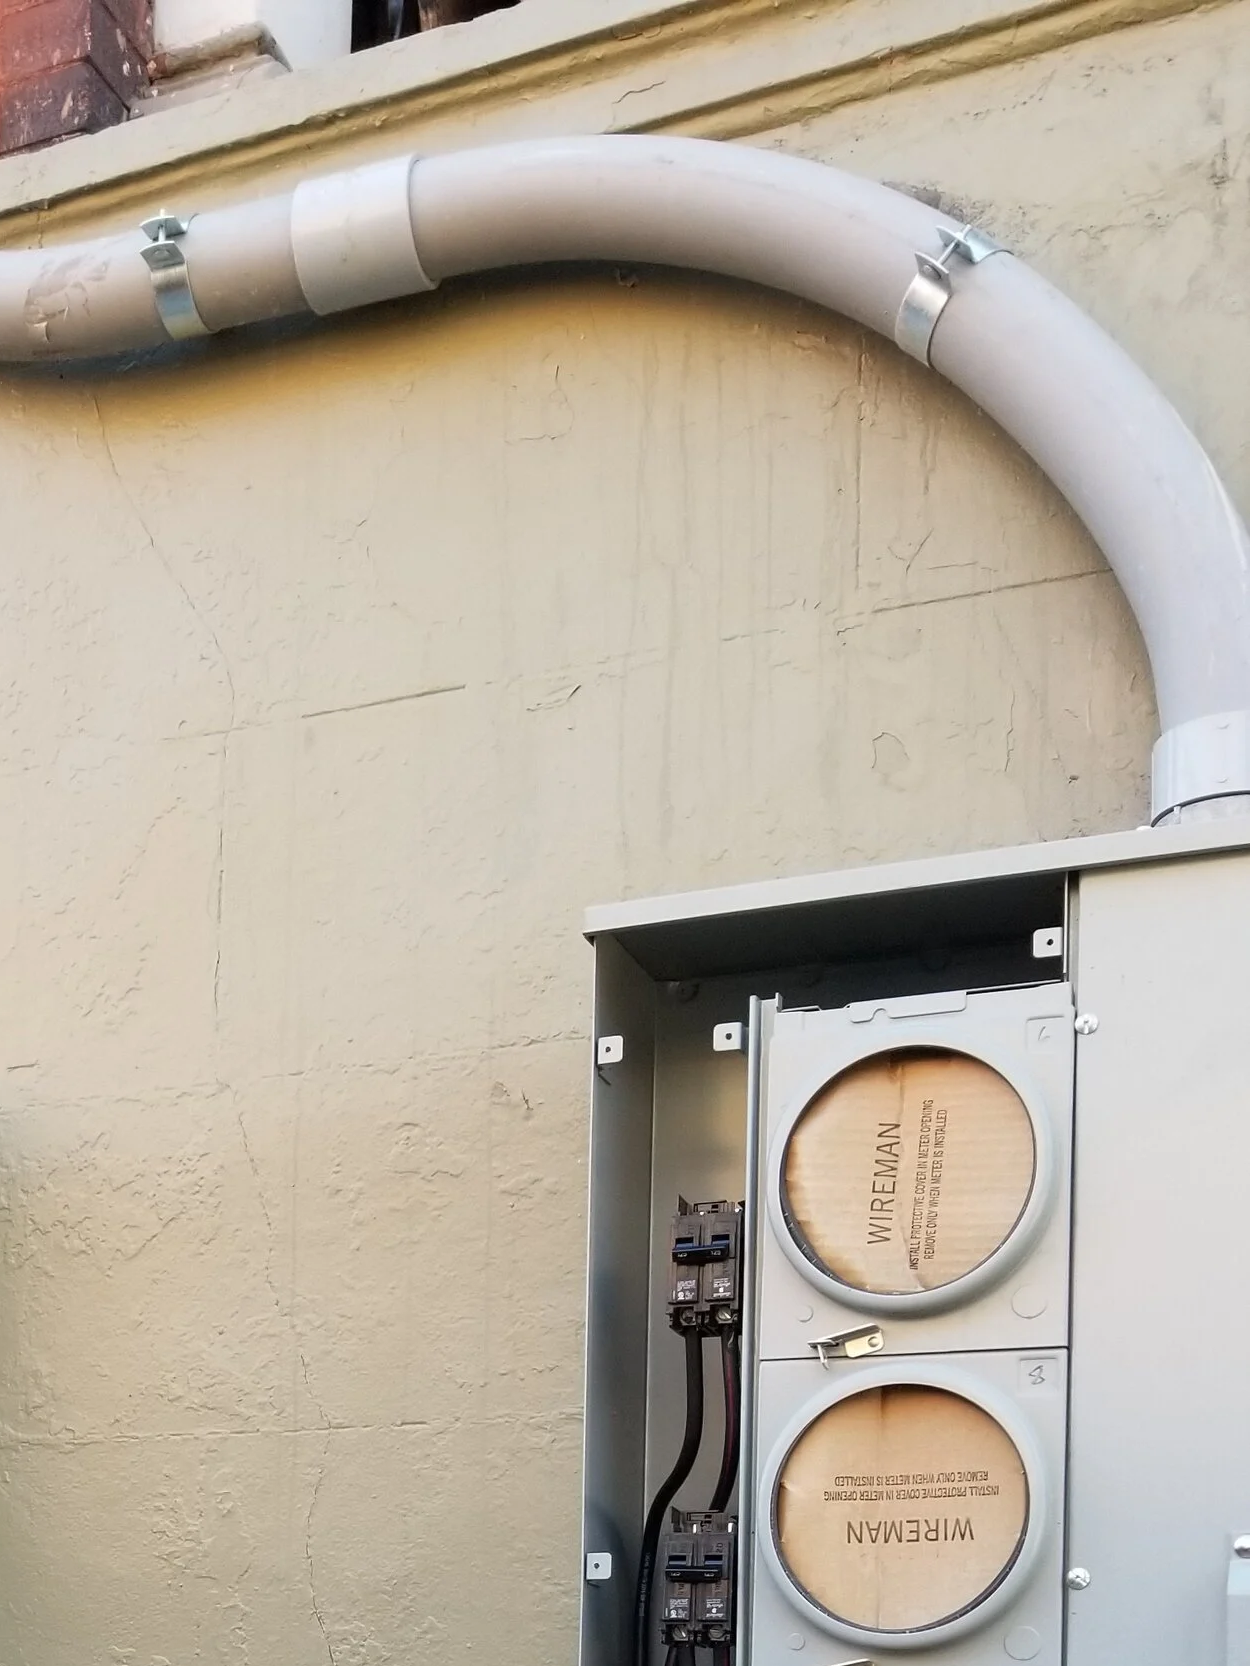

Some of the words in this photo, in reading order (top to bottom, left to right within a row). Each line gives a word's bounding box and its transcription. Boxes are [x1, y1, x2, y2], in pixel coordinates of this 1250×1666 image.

[920, 1099, 934, 1132] OPENING
[934, 1109, 948, 1148] INSTALLED
[918, 1135, 931, 1159] METER
[933, 1149, 944, 1158] IS
[917, 1160, 928, 1169] IN
[930, 1159, 944, 1185] METER
[866, 1122, 902, 1245] WIREMAN
[915, 1170, 927, 1195] COVER
[928, 1185, 941, 1209] WHEN
[911, 1196, 925, 1240] PROTECTIVE
[925, 1209, 939, 1229] ONLY
[923, 1229, 937, 1260] REMOVE
[909, 1241, 921, 1271] INSTALL
[1028, 1364, 1046, 1385] 8
[834, 1475, 875, 1487] INSTALLED
[876, 1475, 884, 1486] IS
[884, 1474, 911, 1486] METER
[912, 1473, 936, 1485] WHEN
[936, 1471, 956, 1484] ONLY
[957, 1470, 989, 1482] REMOVE
[824, 1490, 858, 1502] OPENING
[859, 1490, 885, 1501] METER
[886, 1489, 894, 1500] IN
[895, 1488, 920, 1500] COVER
[921, 1487, 967, 1499] PROTECTIVE
[968, 1485, 1000, 1497] INSTALL
[847, 1517, 975, 1544] WIREMAN
